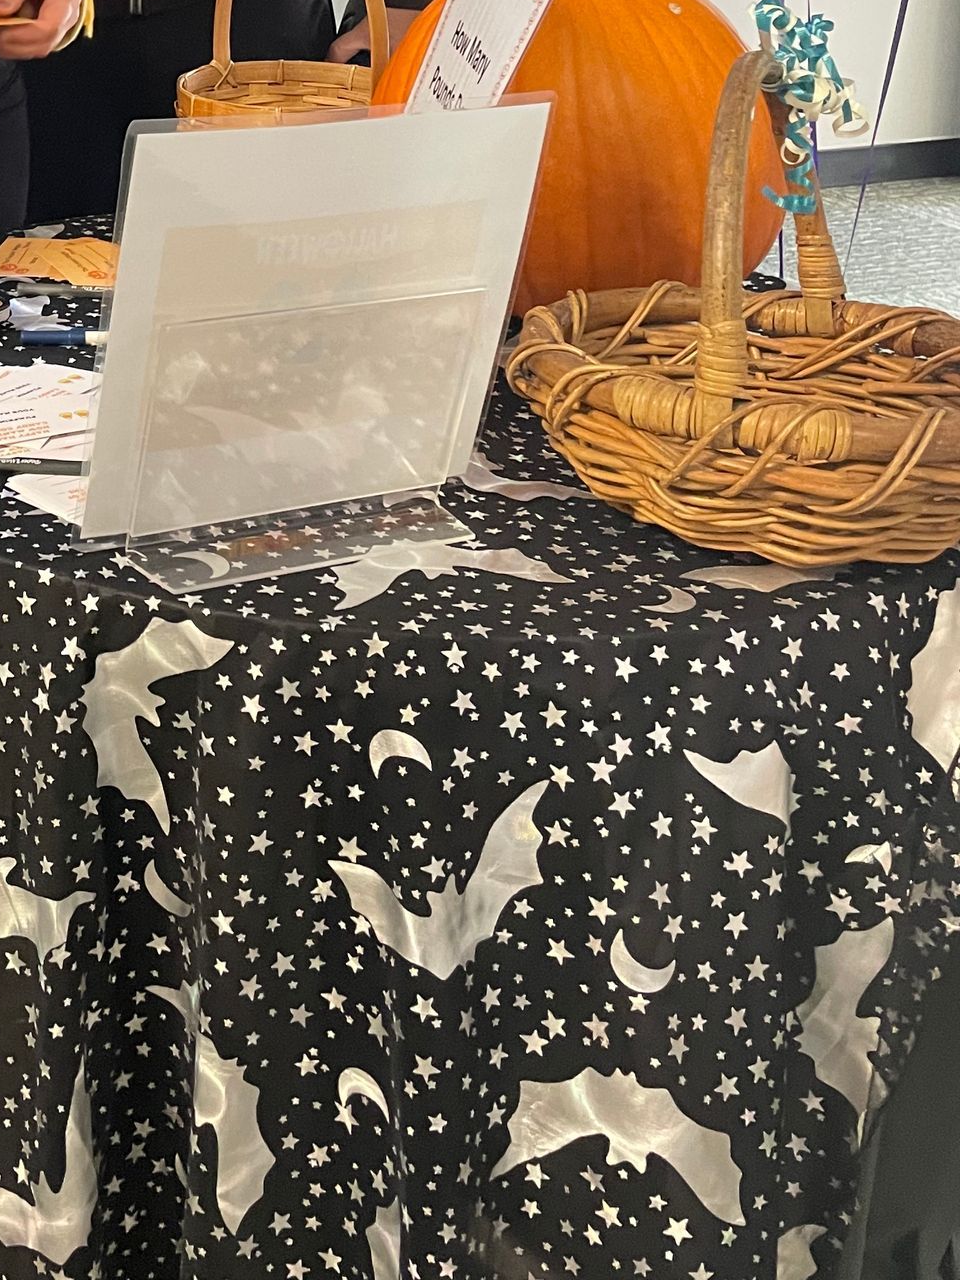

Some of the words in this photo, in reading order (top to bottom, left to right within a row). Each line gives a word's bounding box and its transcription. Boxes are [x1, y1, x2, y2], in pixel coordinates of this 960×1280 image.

[450, 20, 471, 56] How
[465, 35, 492, 84] Many
[429, 65, 456, 110] Pounds
